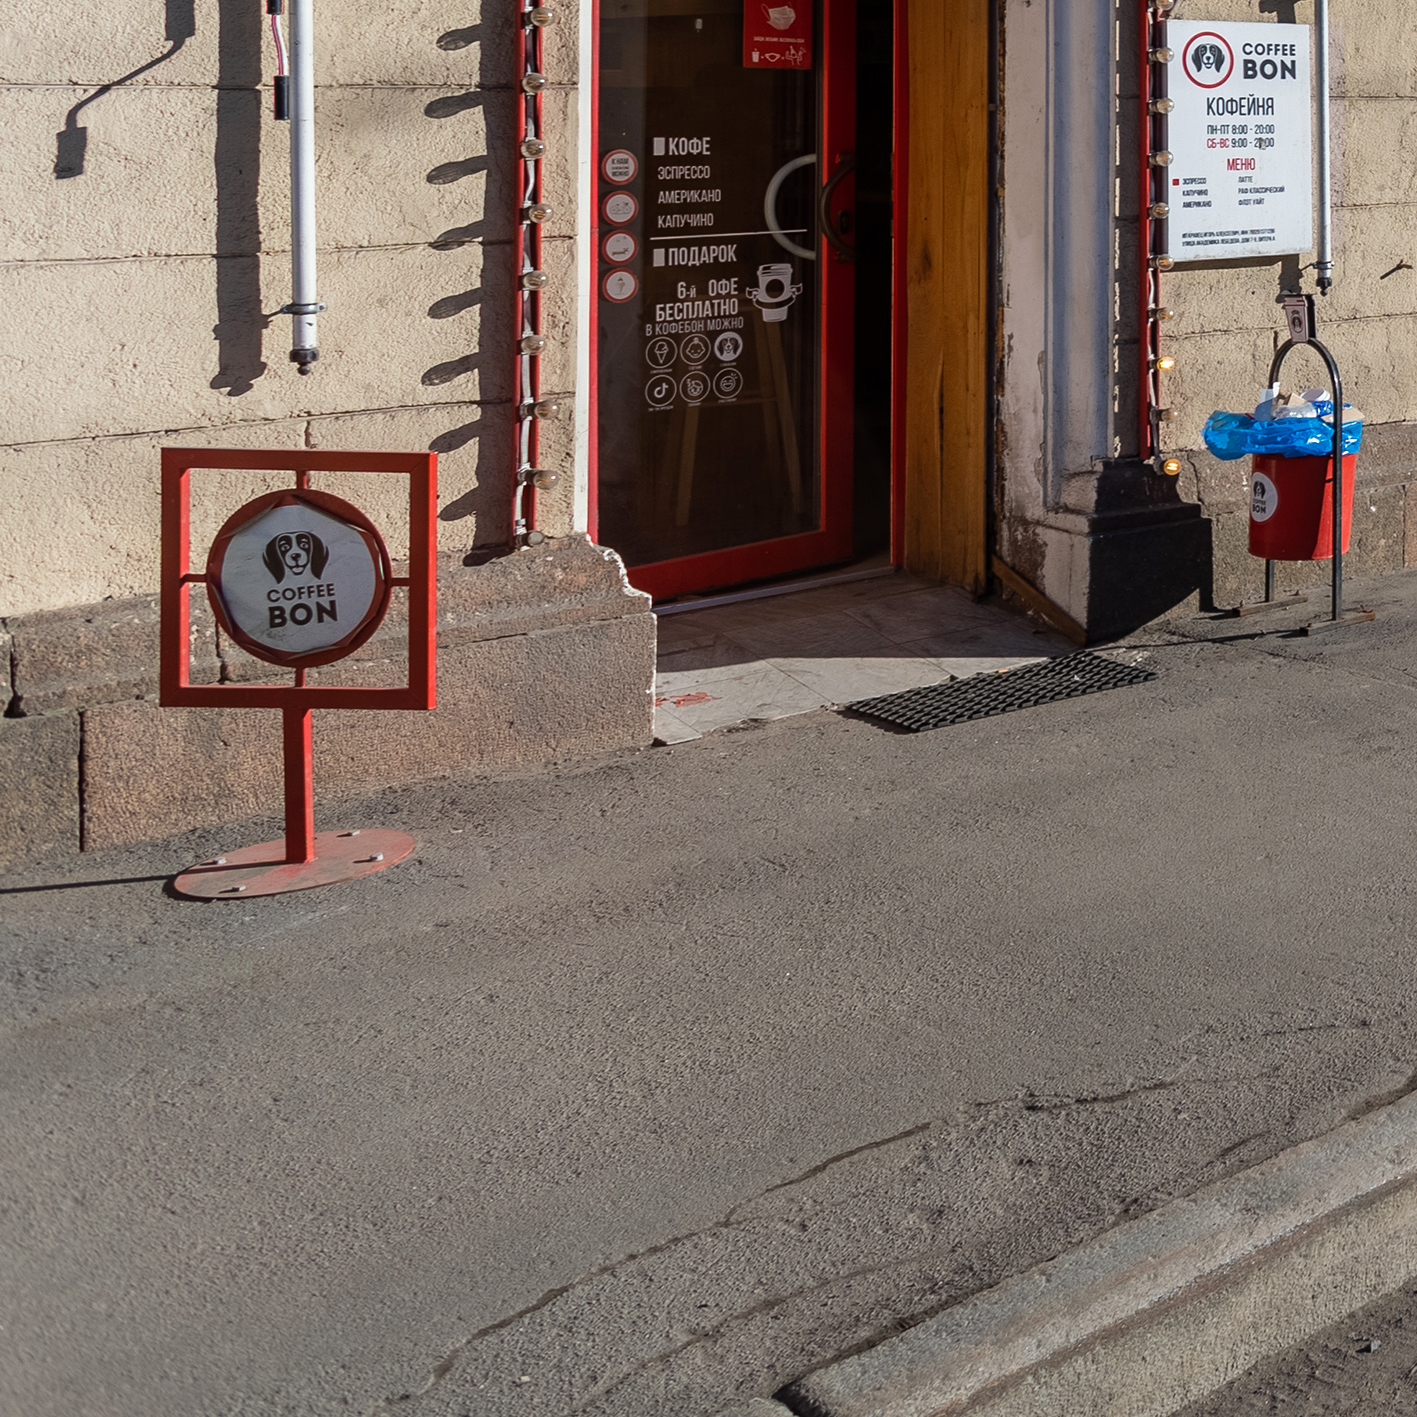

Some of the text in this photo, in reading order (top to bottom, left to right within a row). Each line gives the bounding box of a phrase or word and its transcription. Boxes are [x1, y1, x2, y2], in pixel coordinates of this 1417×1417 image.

[1242, 43, 1296, 56] COFFEE
[1243, 59, 1297, 80] BON
[1206, 93, 1275, 116] КОФЕЙНЯ
[1206, 124, 1230, 135] ПН-ПТ
[1231, 124, 1248, 135] 8:00
[1254, 124, 1275, 135] 20:00
[669, 137, 711, 156] КОФЕ
[1206, 138, 1230, 149] СБ-ВС
[1231, 137, 1248, 148] 9:00
[657, 165, 711, 180] ЭСПРЕССО
[1226, 158, 1256, 171] МЕНЮ
[657, 189, 722, 205] АМЕРИКАНО
[657, 213, 714, 229] КАПУЧИНО
[668, 244, 738, 267] ПОДАРОК
[677, 278, 739, 299] 6-й ОФЕ
[655, 298, 739, 322] БЕСПЛАТНО
[645, 317, 745, 337] В КОФЕБОН МОЖНО
[1252, 504, 1266, 514] BON
[266, 582, 336, 603] COFFEE
[268, 599, 339, 629] BON
